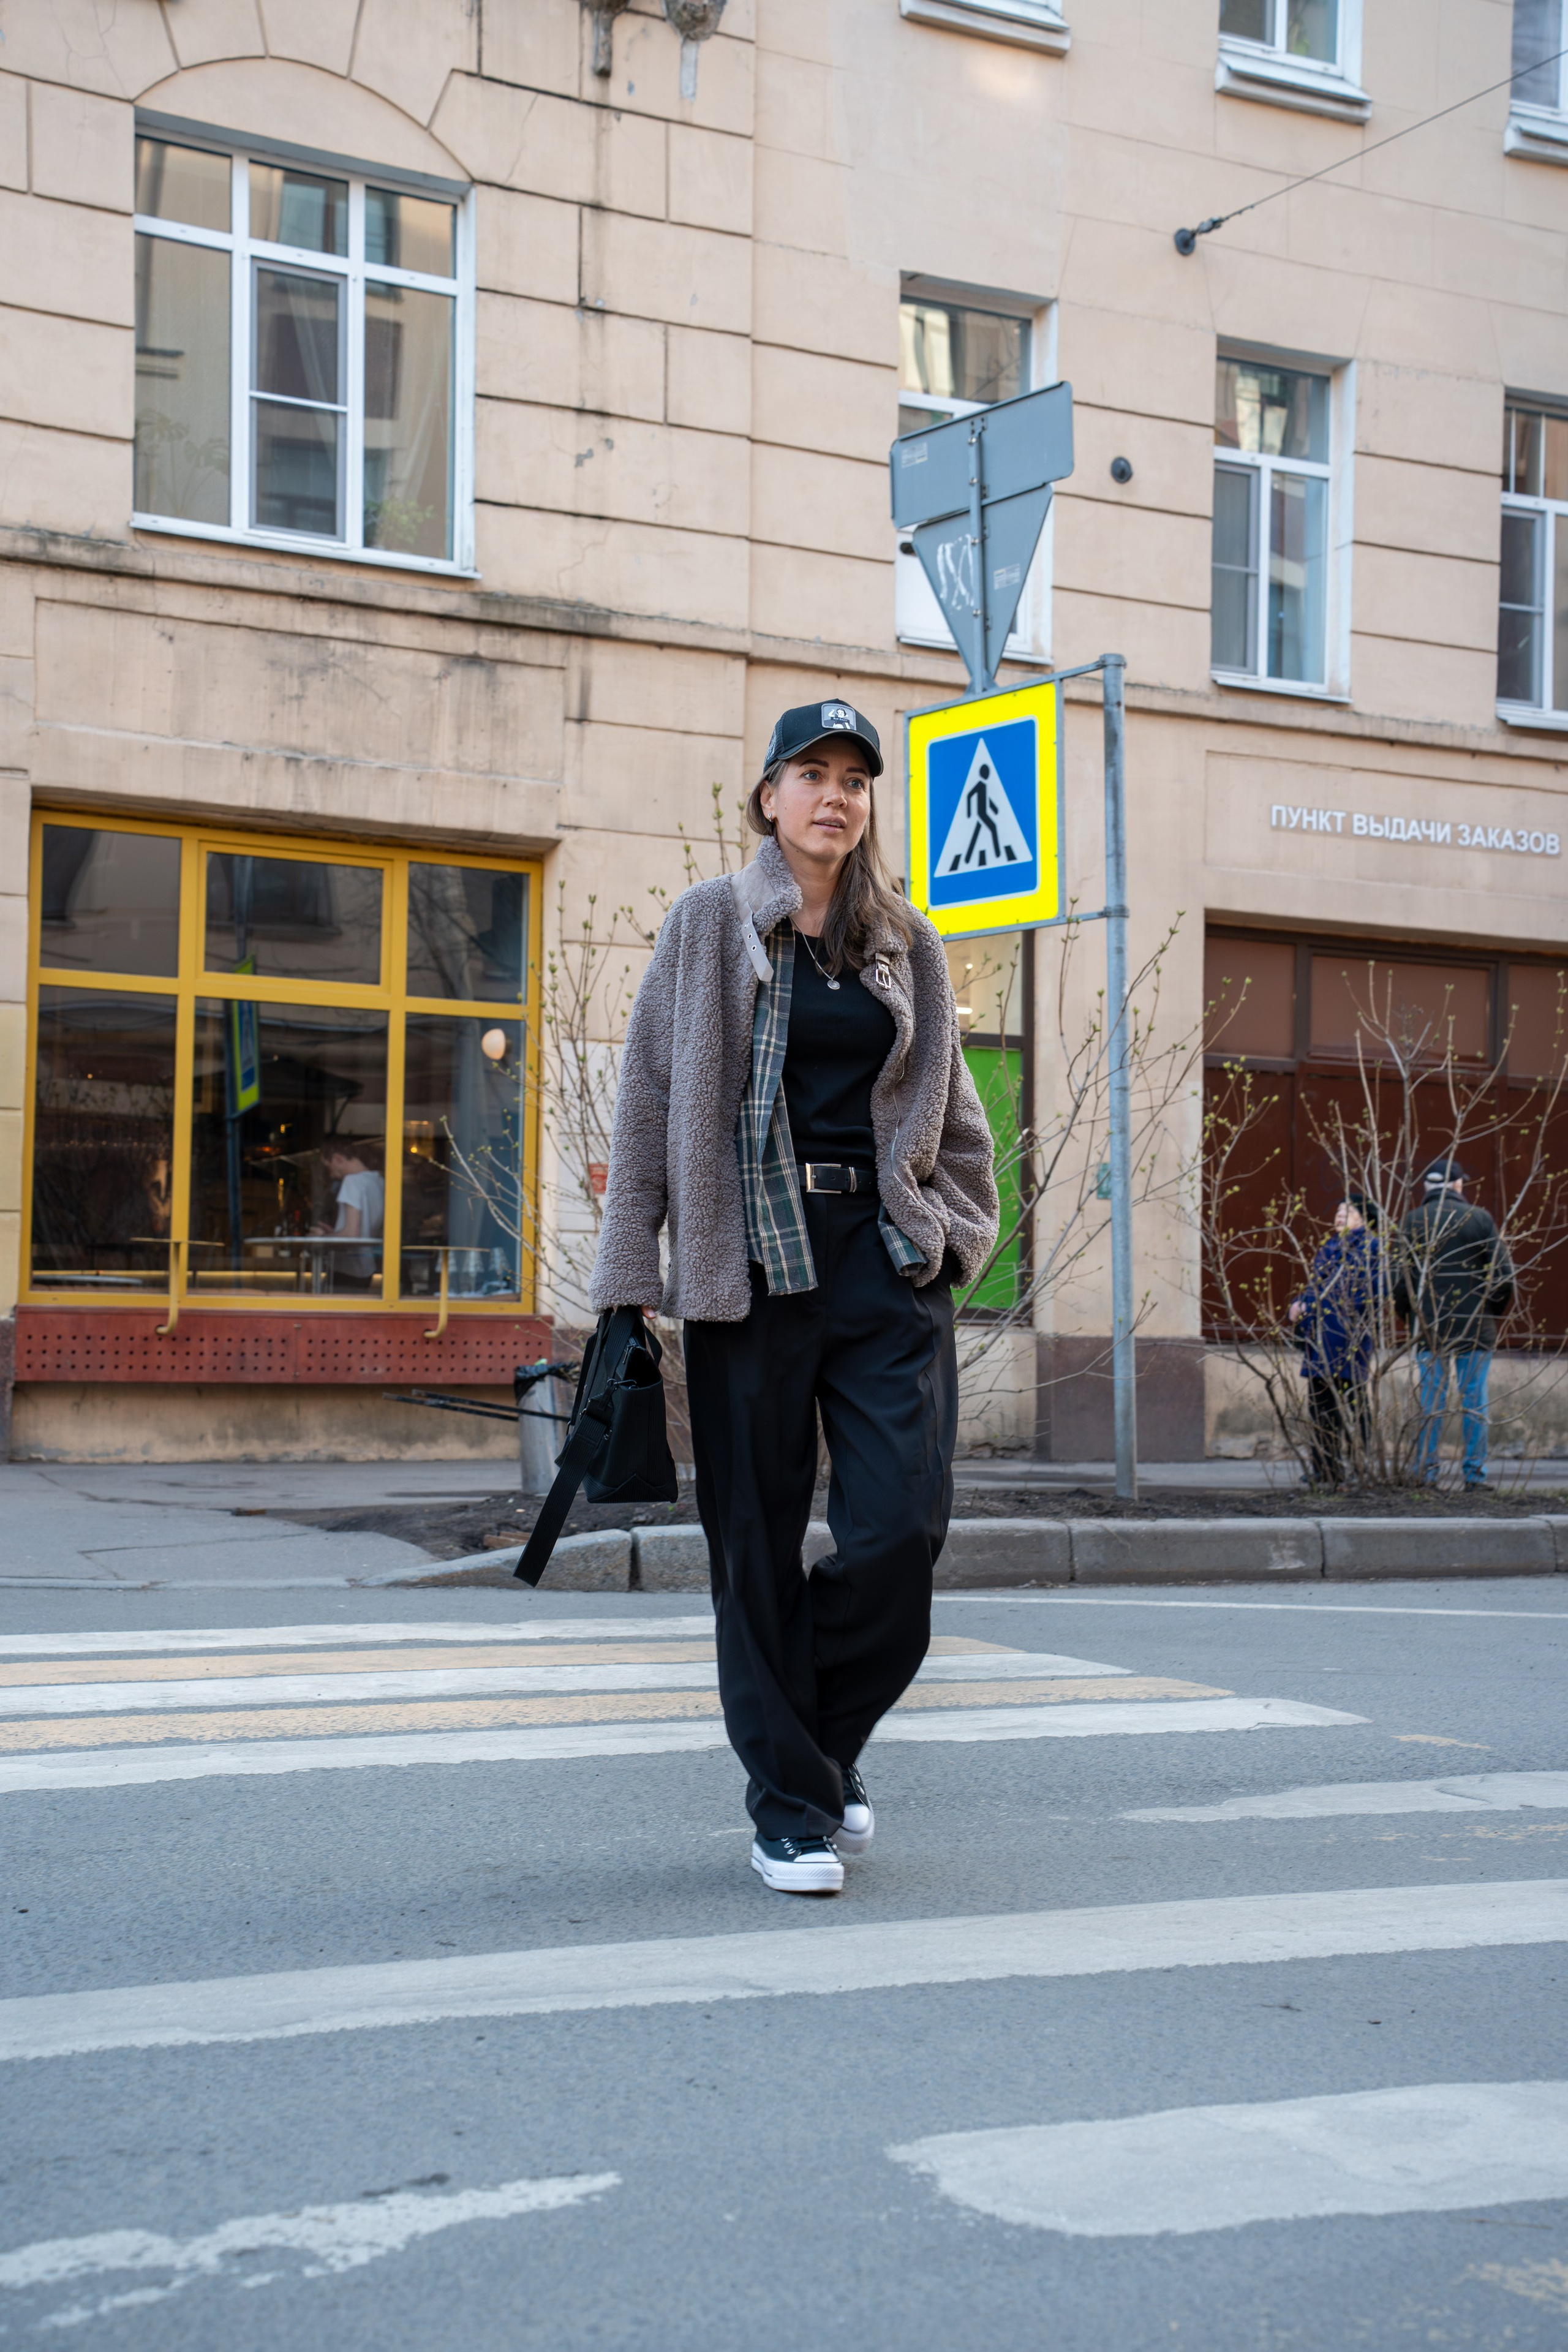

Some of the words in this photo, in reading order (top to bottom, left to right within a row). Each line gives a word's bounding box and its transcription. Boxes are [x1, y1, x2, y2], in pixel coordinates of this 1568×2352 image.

[1271, 805, 1346, 833] ПУНКТ
[1352, 813, 1452, 845] ВЫДАЧИ
[1457, 823, 1561, 855] ЗАКАЗОВ
